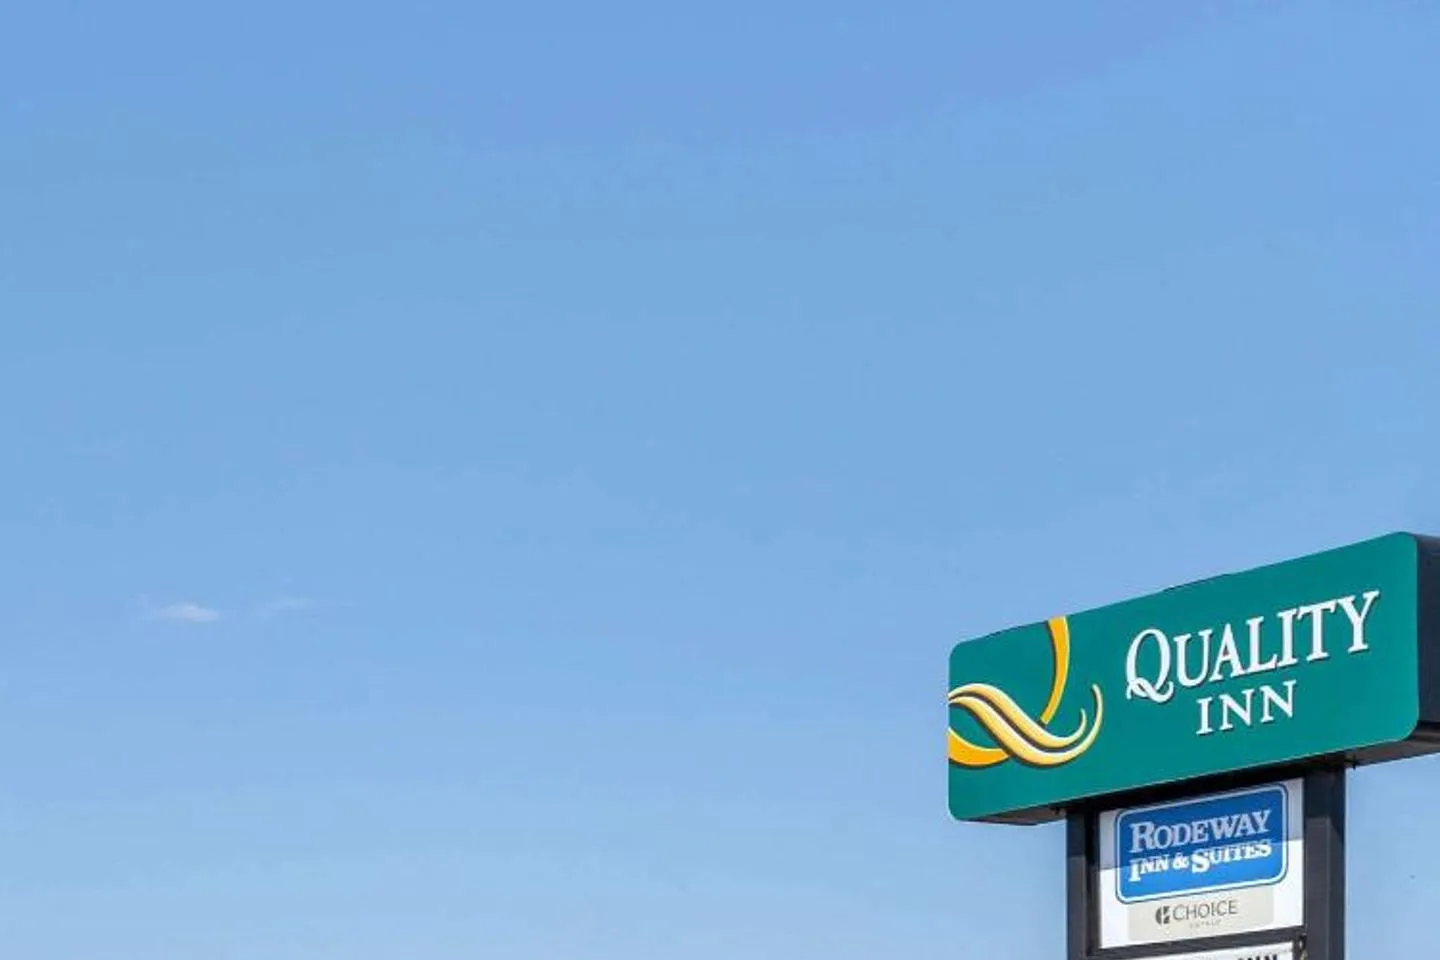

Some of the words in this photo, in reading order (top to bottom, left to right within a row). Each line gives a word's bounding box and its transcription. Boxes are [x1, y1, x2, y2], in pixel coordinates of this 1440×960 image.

[1125, 590, 1380, 704] QUALITY
[1195, 680, 1298, 736] INN
[1129, 808, 1272, 853] RODEWAY
[1128, 854, 1169, 882] INN
[1172, 852, 1189, 870] &
[1191, 839, 1272, 873] SUITES
[1172, 900, 1239, 921] CHOICE
